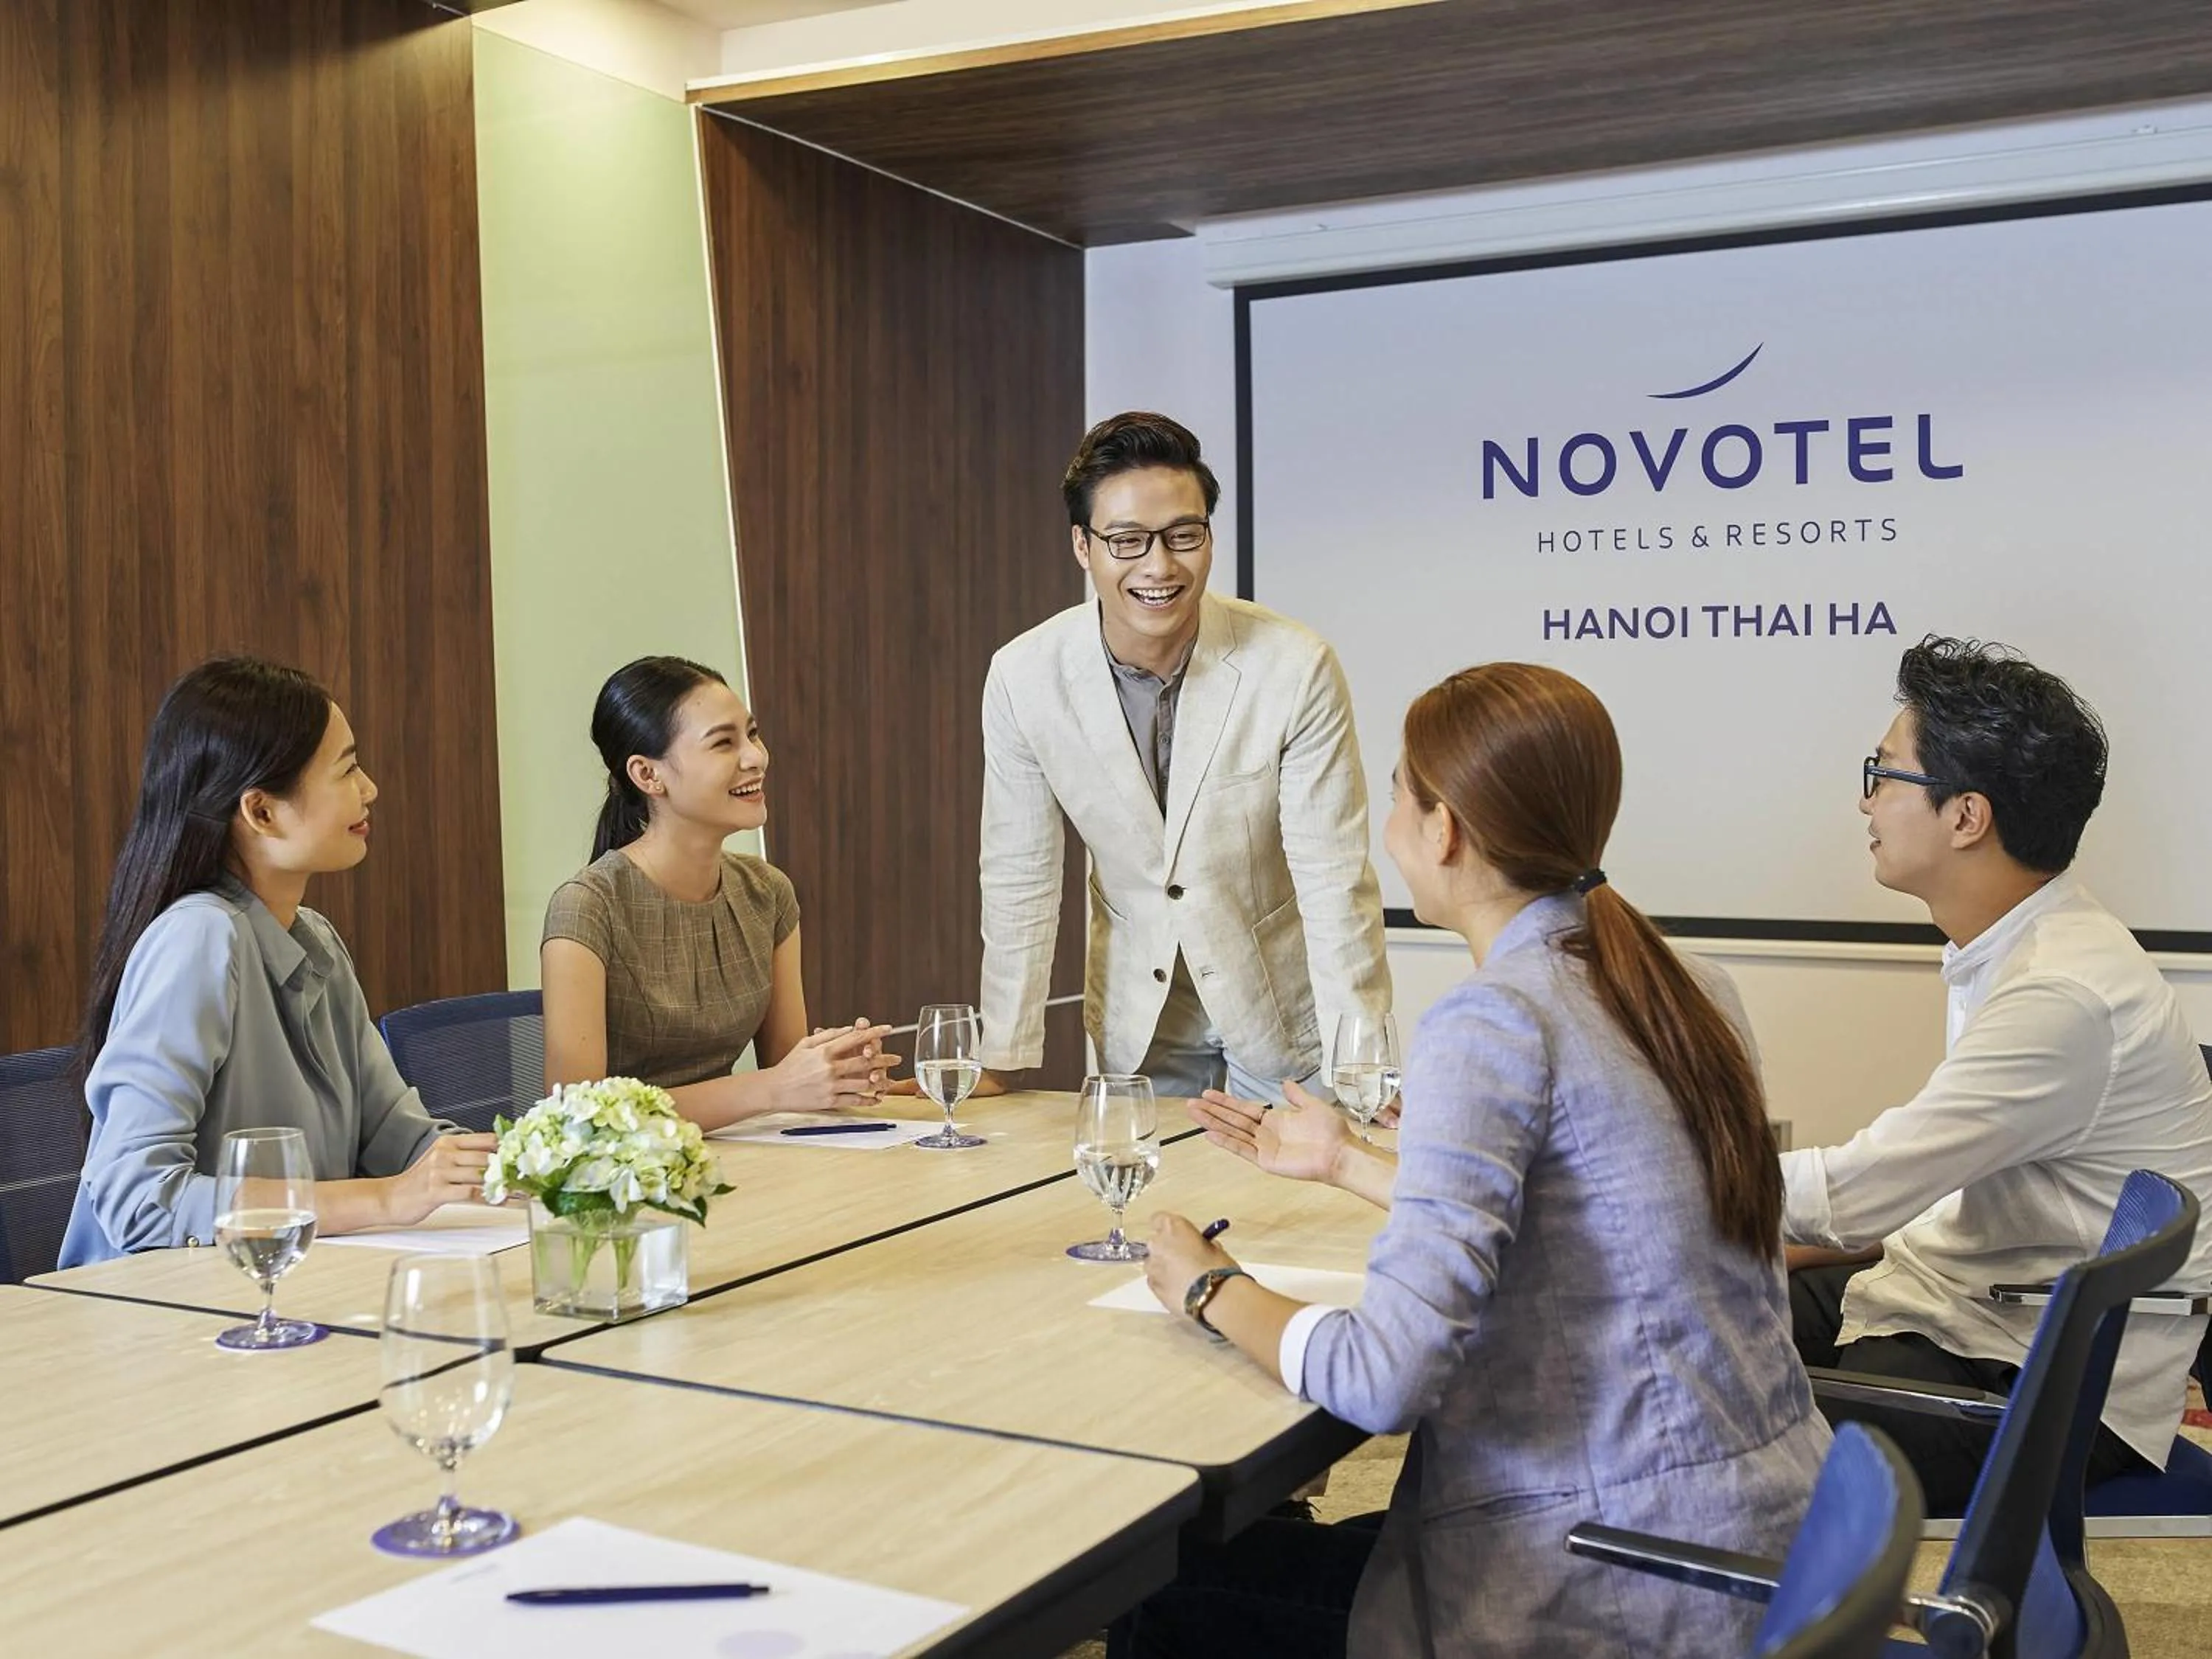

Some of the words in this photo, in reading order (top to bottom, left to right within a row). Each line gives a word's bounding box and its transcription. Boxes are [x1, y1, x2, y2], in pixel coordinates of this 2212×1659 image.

[1481, 413, 1964, 500] NOVOTEL
[1538, 528, 1673, 554] HOTELS
[1691, 525, 1710, 548] &
[1726, 518, 1897, 547] RESORTS
[1543, 606, 1688, 641] HANOI
[1701, 603, 1812, 638] THAI
[1829, 601, 1897, 636] HA
